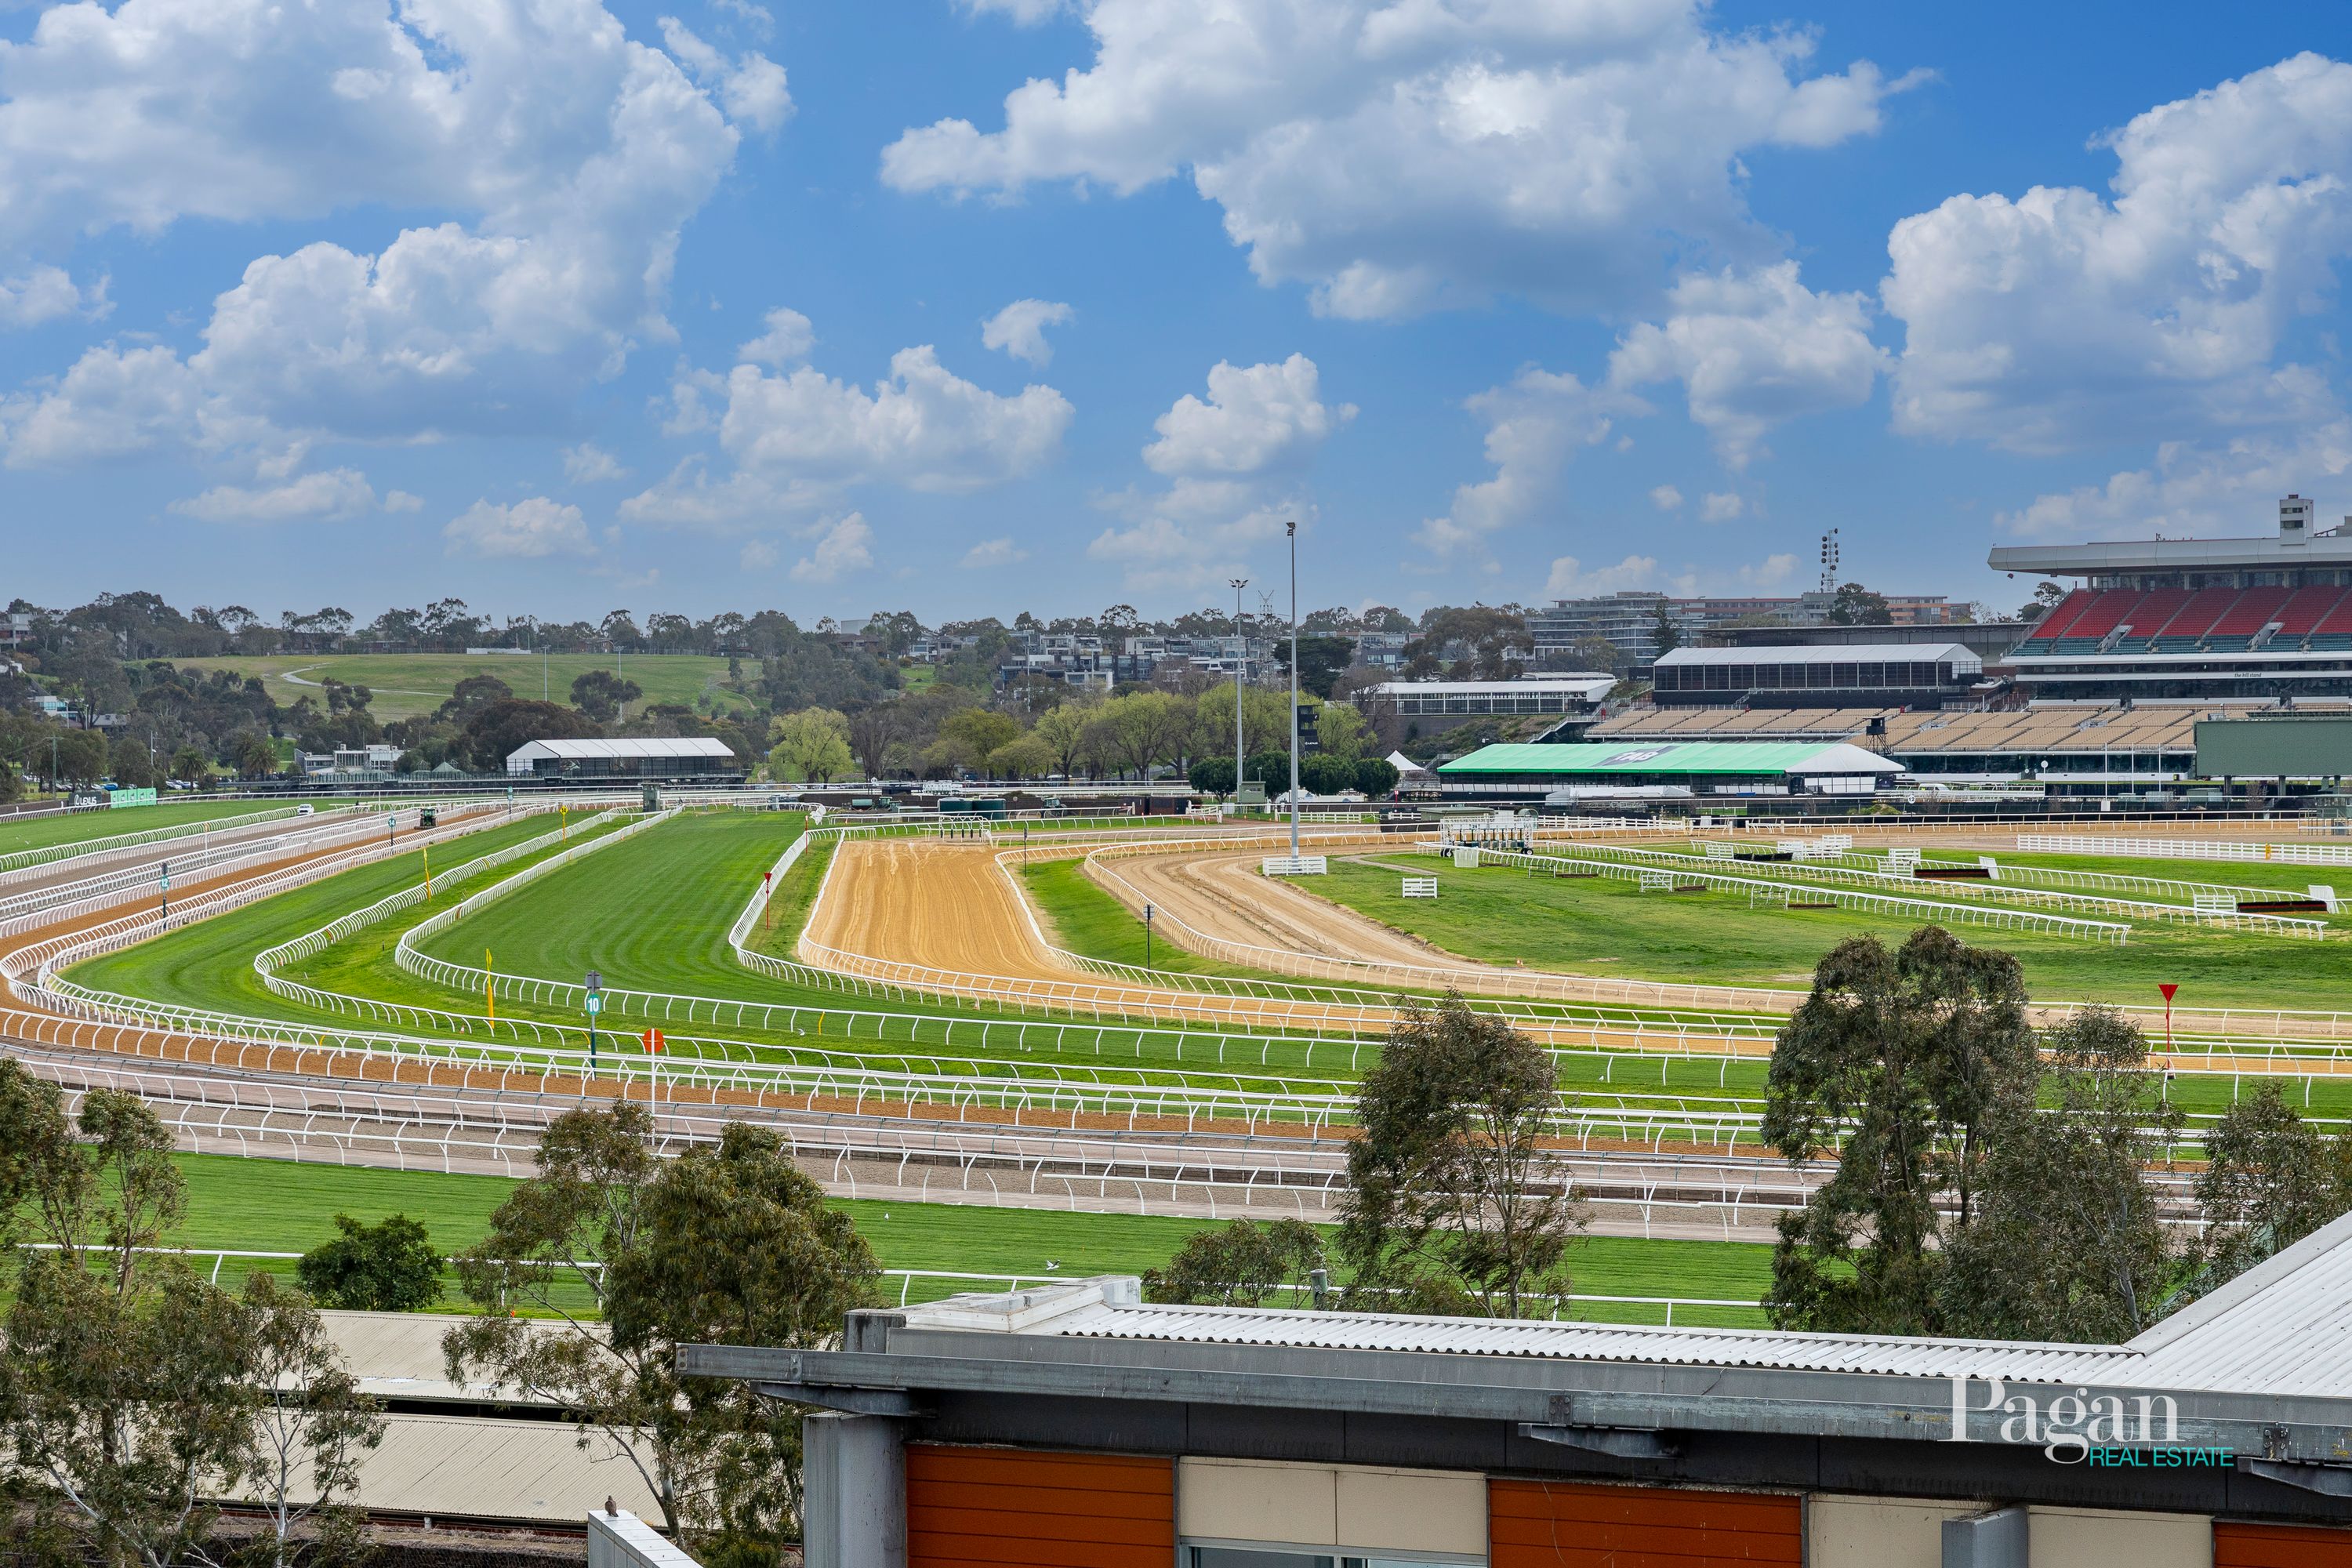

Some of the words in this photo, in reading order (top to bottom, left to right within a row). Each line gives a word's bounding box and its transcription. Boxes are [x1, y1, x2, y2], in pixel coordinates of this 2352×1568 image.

[79, 797, 97, 805] LEXUS
[161, 878, 169, 887] 12
[588, 997, 599, 1012] 10
